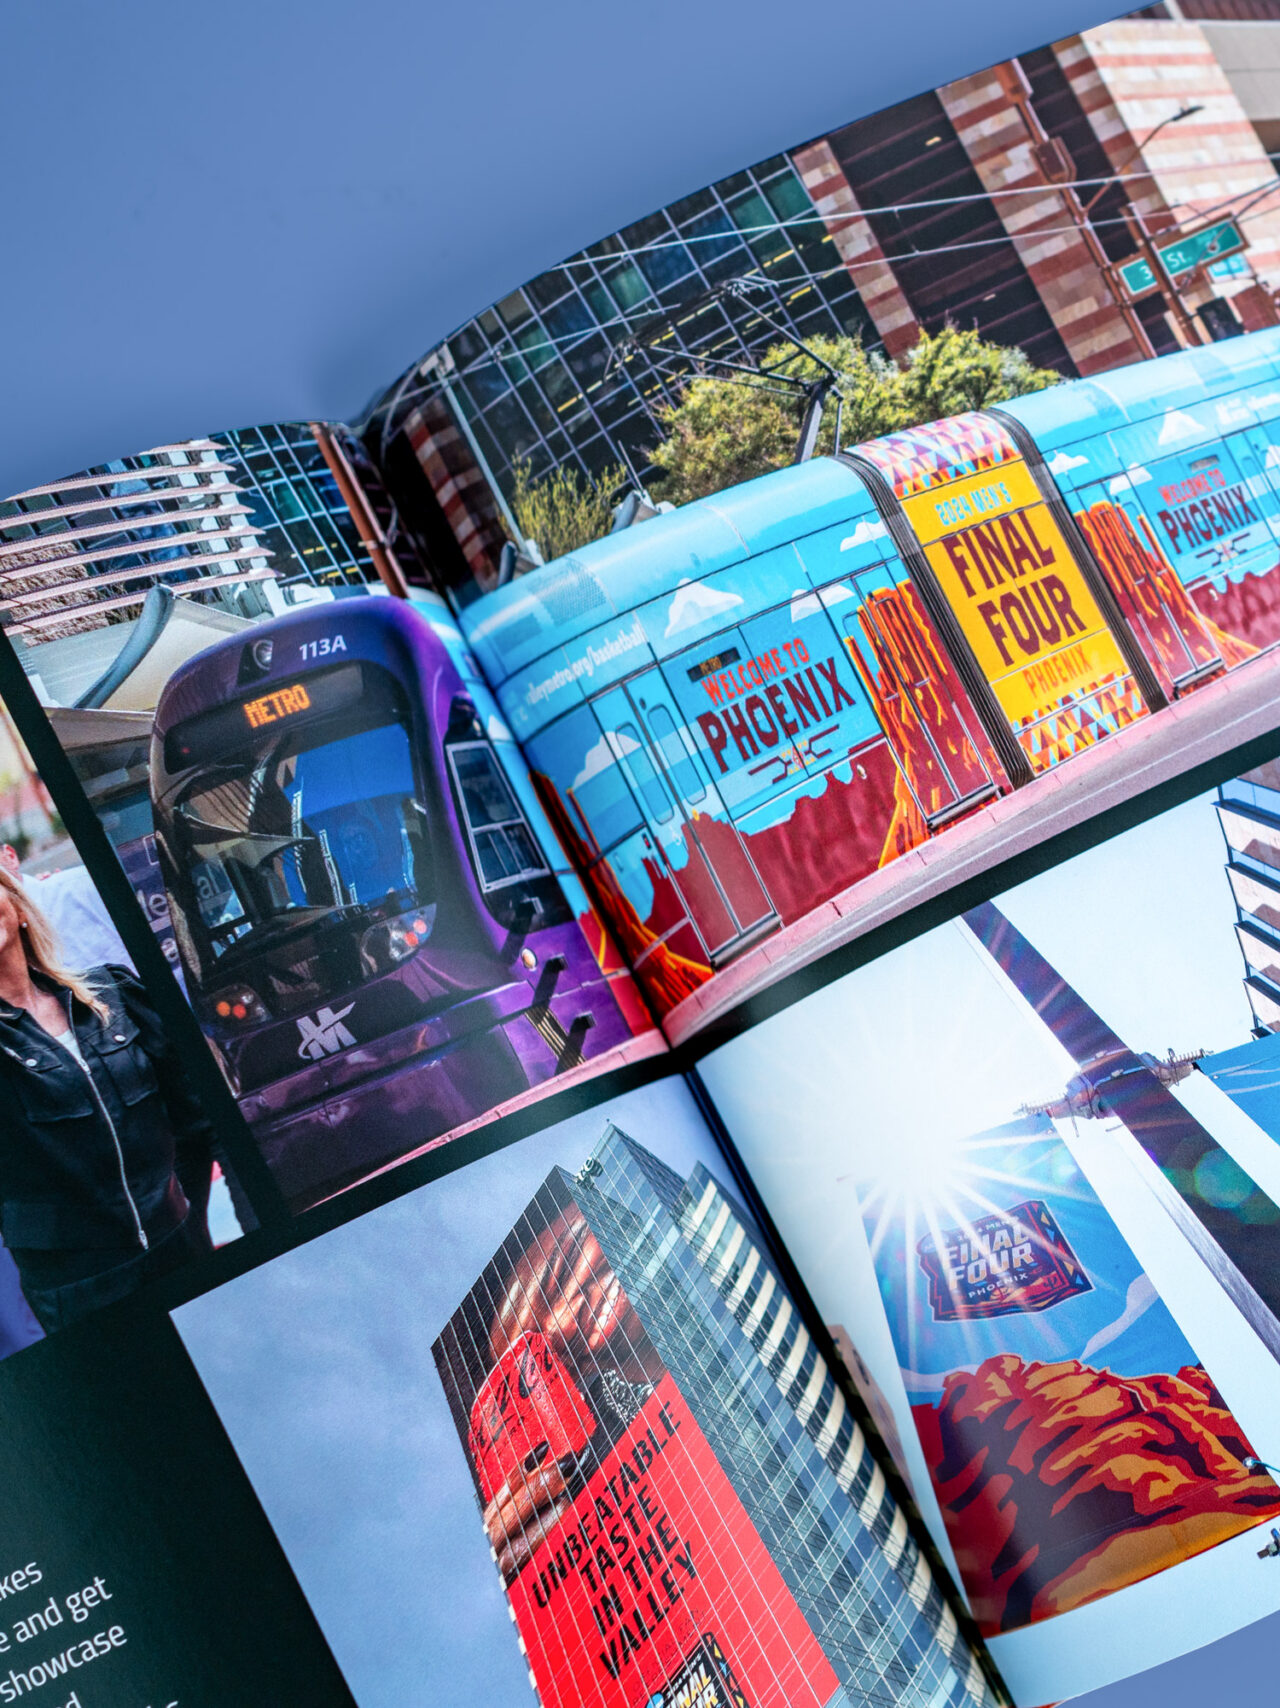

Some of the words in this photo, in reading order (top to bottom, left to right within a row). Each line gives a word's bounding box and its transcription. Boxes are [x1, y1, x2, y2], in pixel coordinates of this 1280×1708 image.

[935, 495, 973, 527] 2024
[971, 482, 1013, 516] MEN'S
[1157, 485, 1258, 555] PHOENIX
[1158, 473, 1212, 507] WELCOME
[1210, 468, 1227, 487] TO
[941, 509, 1057, 599] FINAL
[299, 635, 347, 661] 113A
[977, 573, 1088, 667] FOUR
[700, 649, 782, 707] WELCOME
[785, 637, 811, 668] TO
[1023, 643, 1094, 698] PHOENIX
[243, 684, 311, 728] METRO
[695, 656, 857, 775] PHOENIX
[948, 1223, 1030, 1264] FINAL
[949, 1242, 1035, 1291] FOUR
[968, 1273, 1029, 1298] PHOENIX
[531, 1400, 683, 1609] UNBEATABLE
[579, 1485, 660, 1594] TASTE
[0, 1561, 43, 1601] kes
[590, 1583, 625, 1636] IN
[623, 1512, 681, 1593] THE
[12, 1597, 64, 1643] and
[65, 1576, 113, 1624] get
[599, 1539, 698, 1681] VALLEY
[0, 1625, 128, 1703] showcase
